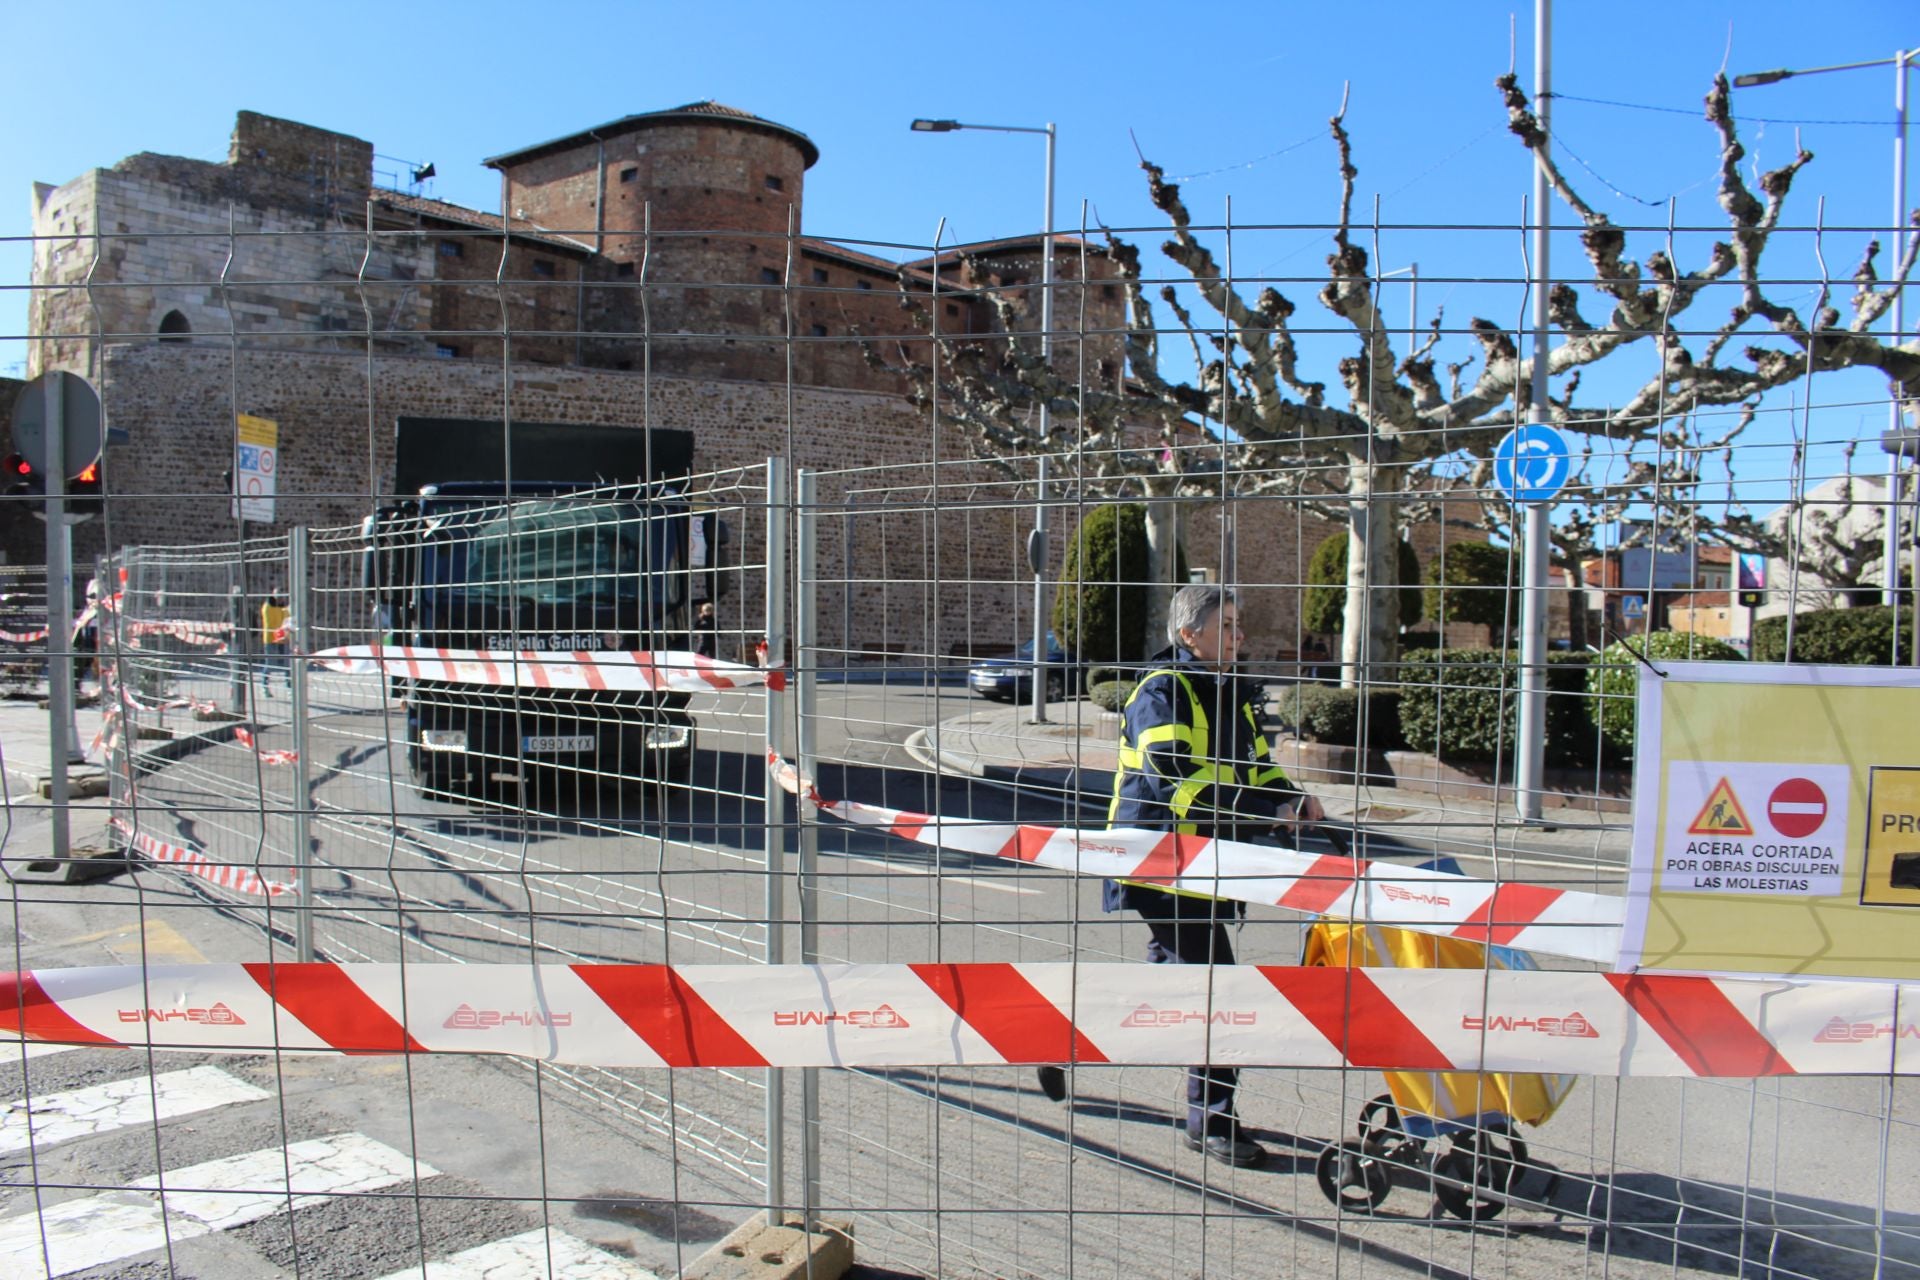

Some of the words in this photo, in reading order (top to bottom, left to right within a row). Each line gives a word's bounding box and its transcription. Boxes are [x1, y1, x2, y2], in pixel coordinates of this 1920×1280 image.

[488, 635, 546, 650] Estella
[1881, 814, 1920, 833] PR
[1686, 841, 1744, 856] ACERA
[1752, 844, 1833, 860] CORTADA
[1667, 859, 1697, 871] POR
[1702, 860, 1752, 873] OBRAS
[1756, 862, 1839, 875] DISCULPEN
[1694, 877, 1721, 888] LAS
[1725, 878, 1808, 891] MOLESTIAS
